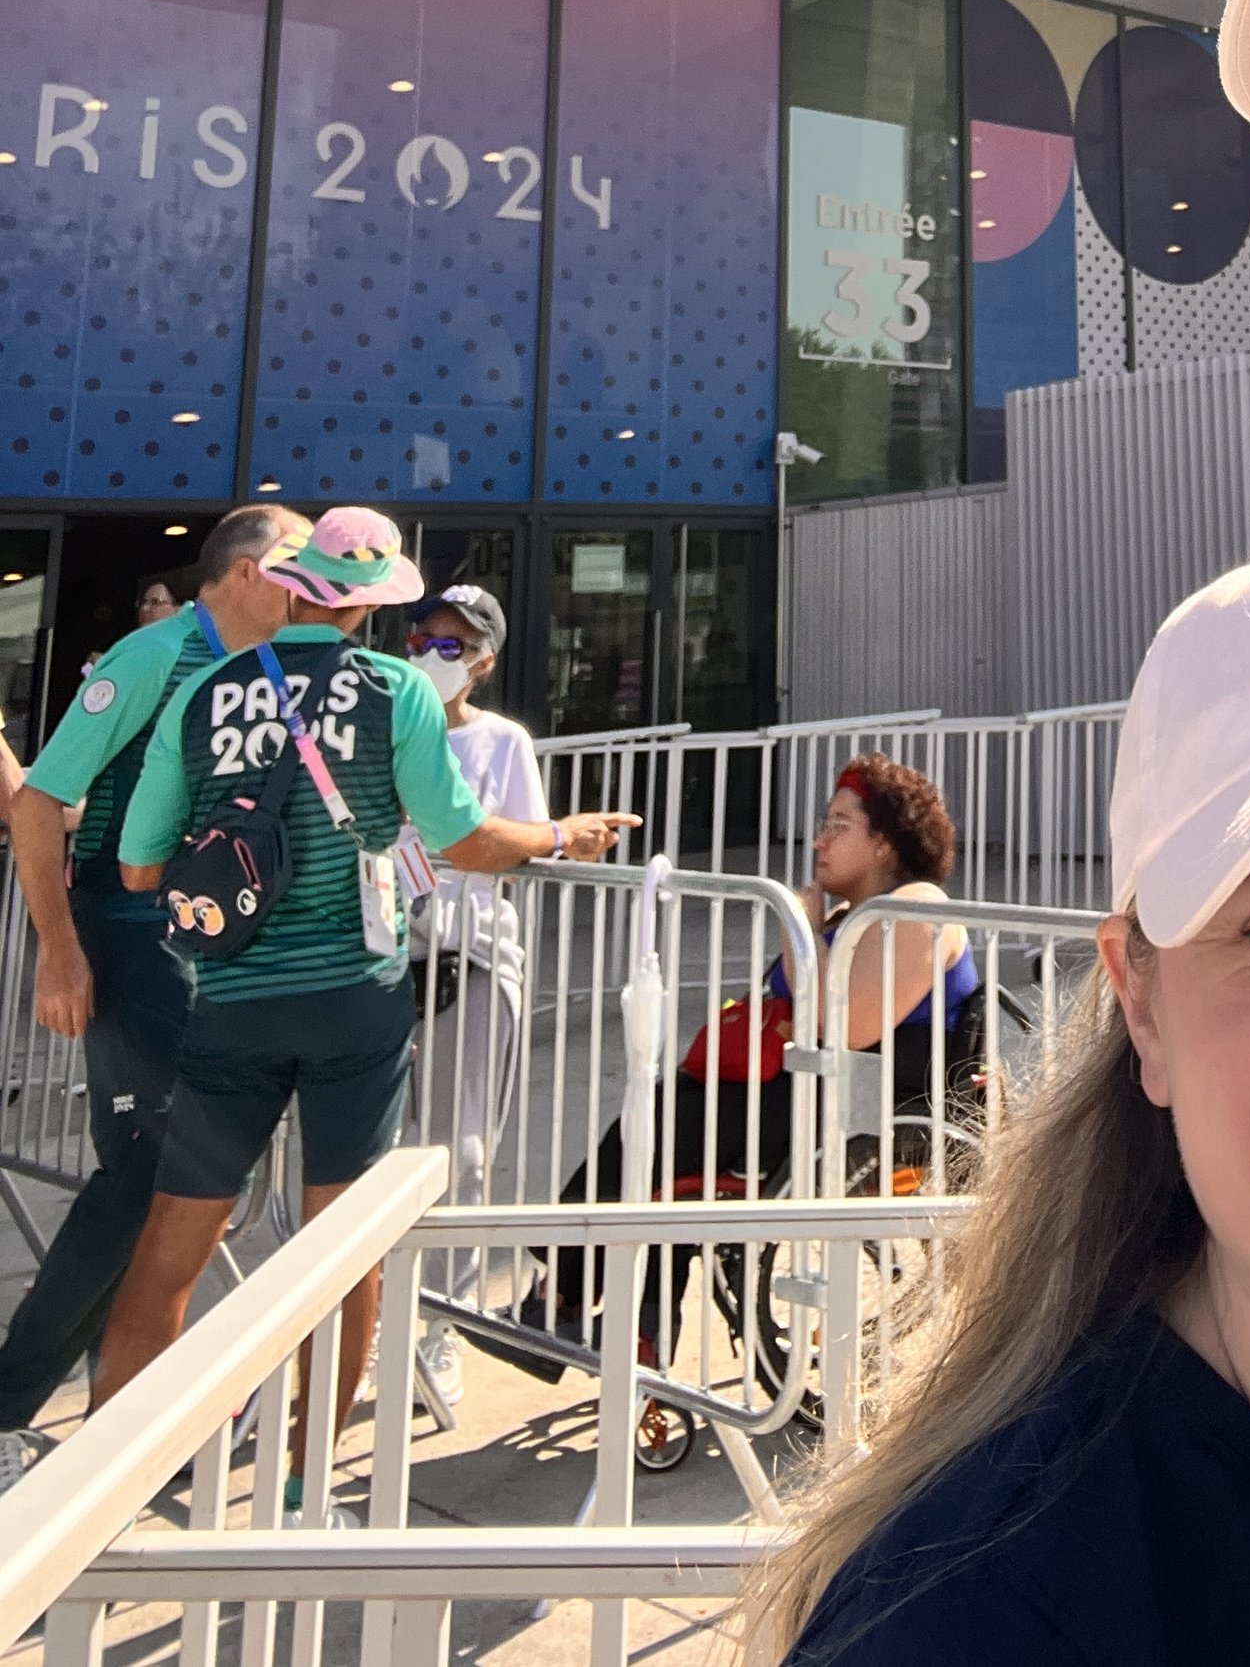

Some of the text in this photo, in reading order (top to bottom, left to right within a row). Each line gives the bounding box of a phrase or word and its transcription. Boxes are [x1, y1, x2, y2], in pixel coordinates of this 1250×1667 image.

[816, 194, 937, 241] Entrée
[821, 249, 932, 344] 33
[211, 670, 361, 728] PARS
[210, 714, 356, 776] 204
